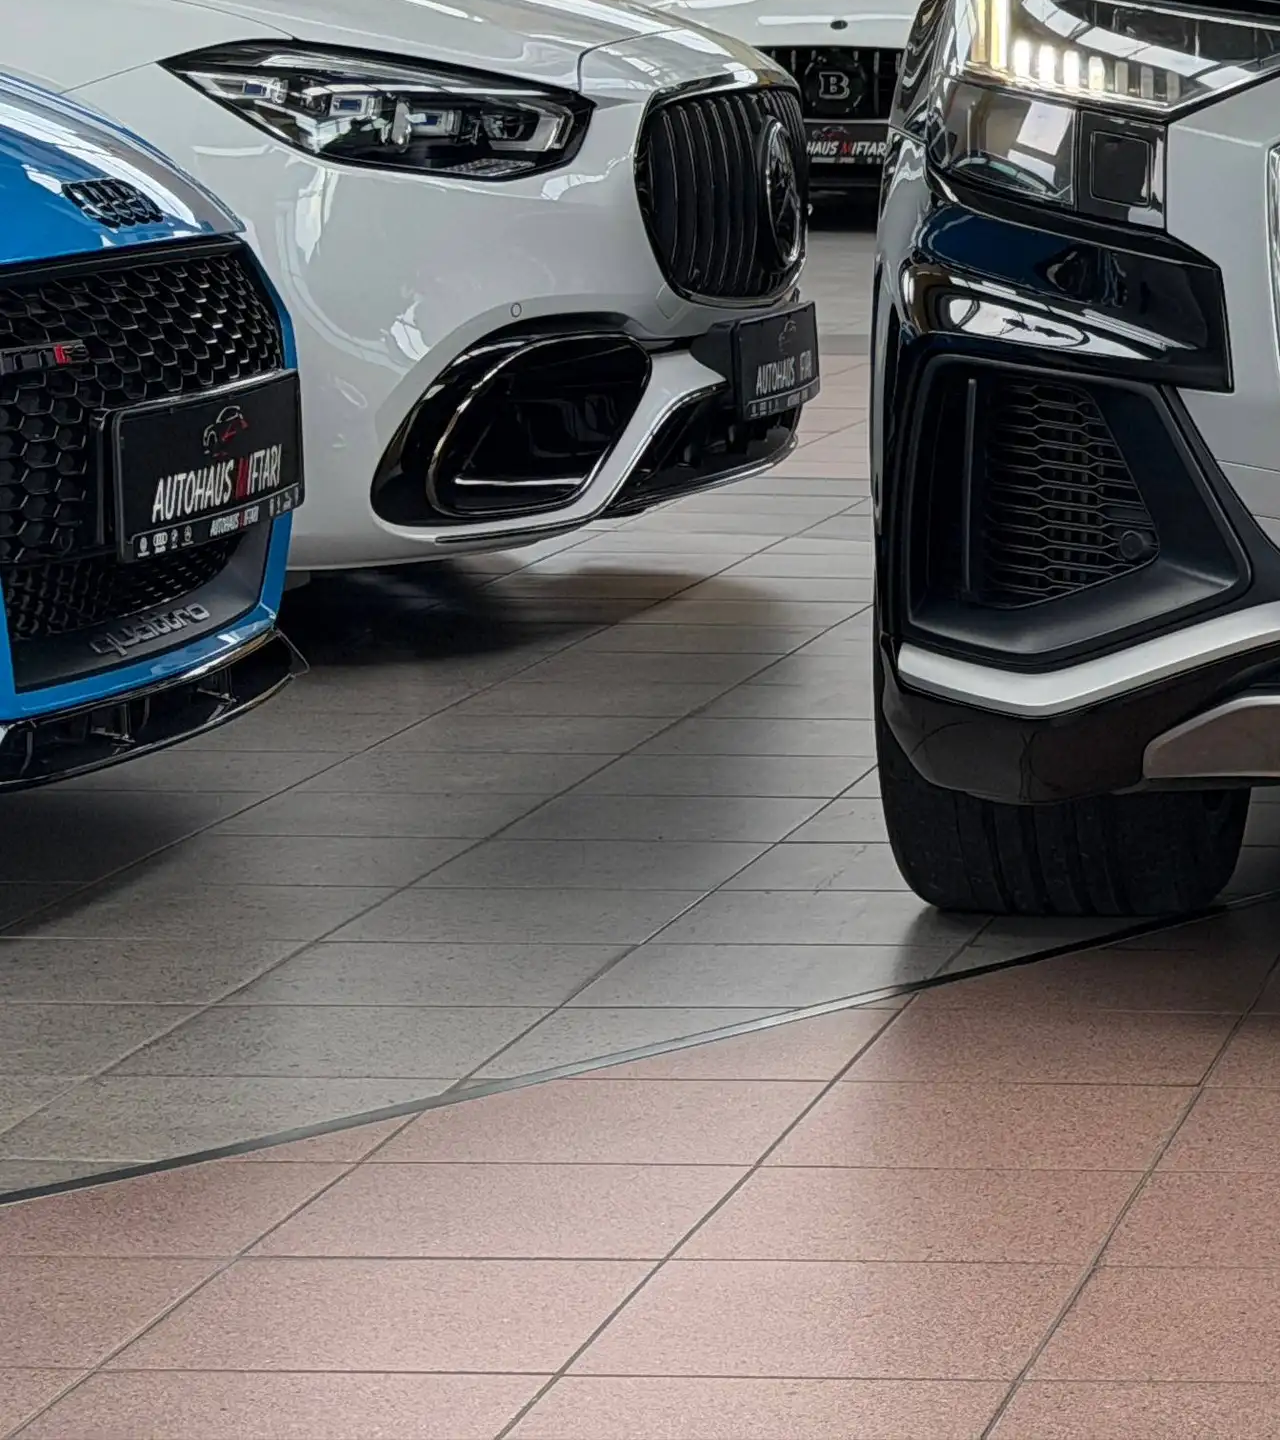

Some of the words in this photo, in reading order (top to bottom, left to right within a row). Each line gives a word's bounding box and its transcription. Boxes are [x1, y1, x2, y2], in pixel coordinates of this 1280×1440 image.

[756, 356, 795, 397] AUTOHAUS
[152, 459, 235, 524] AUTOHAUS
[235, 443, 283, 501] MIFTARI
[89, 603, 211, 657] quattro
